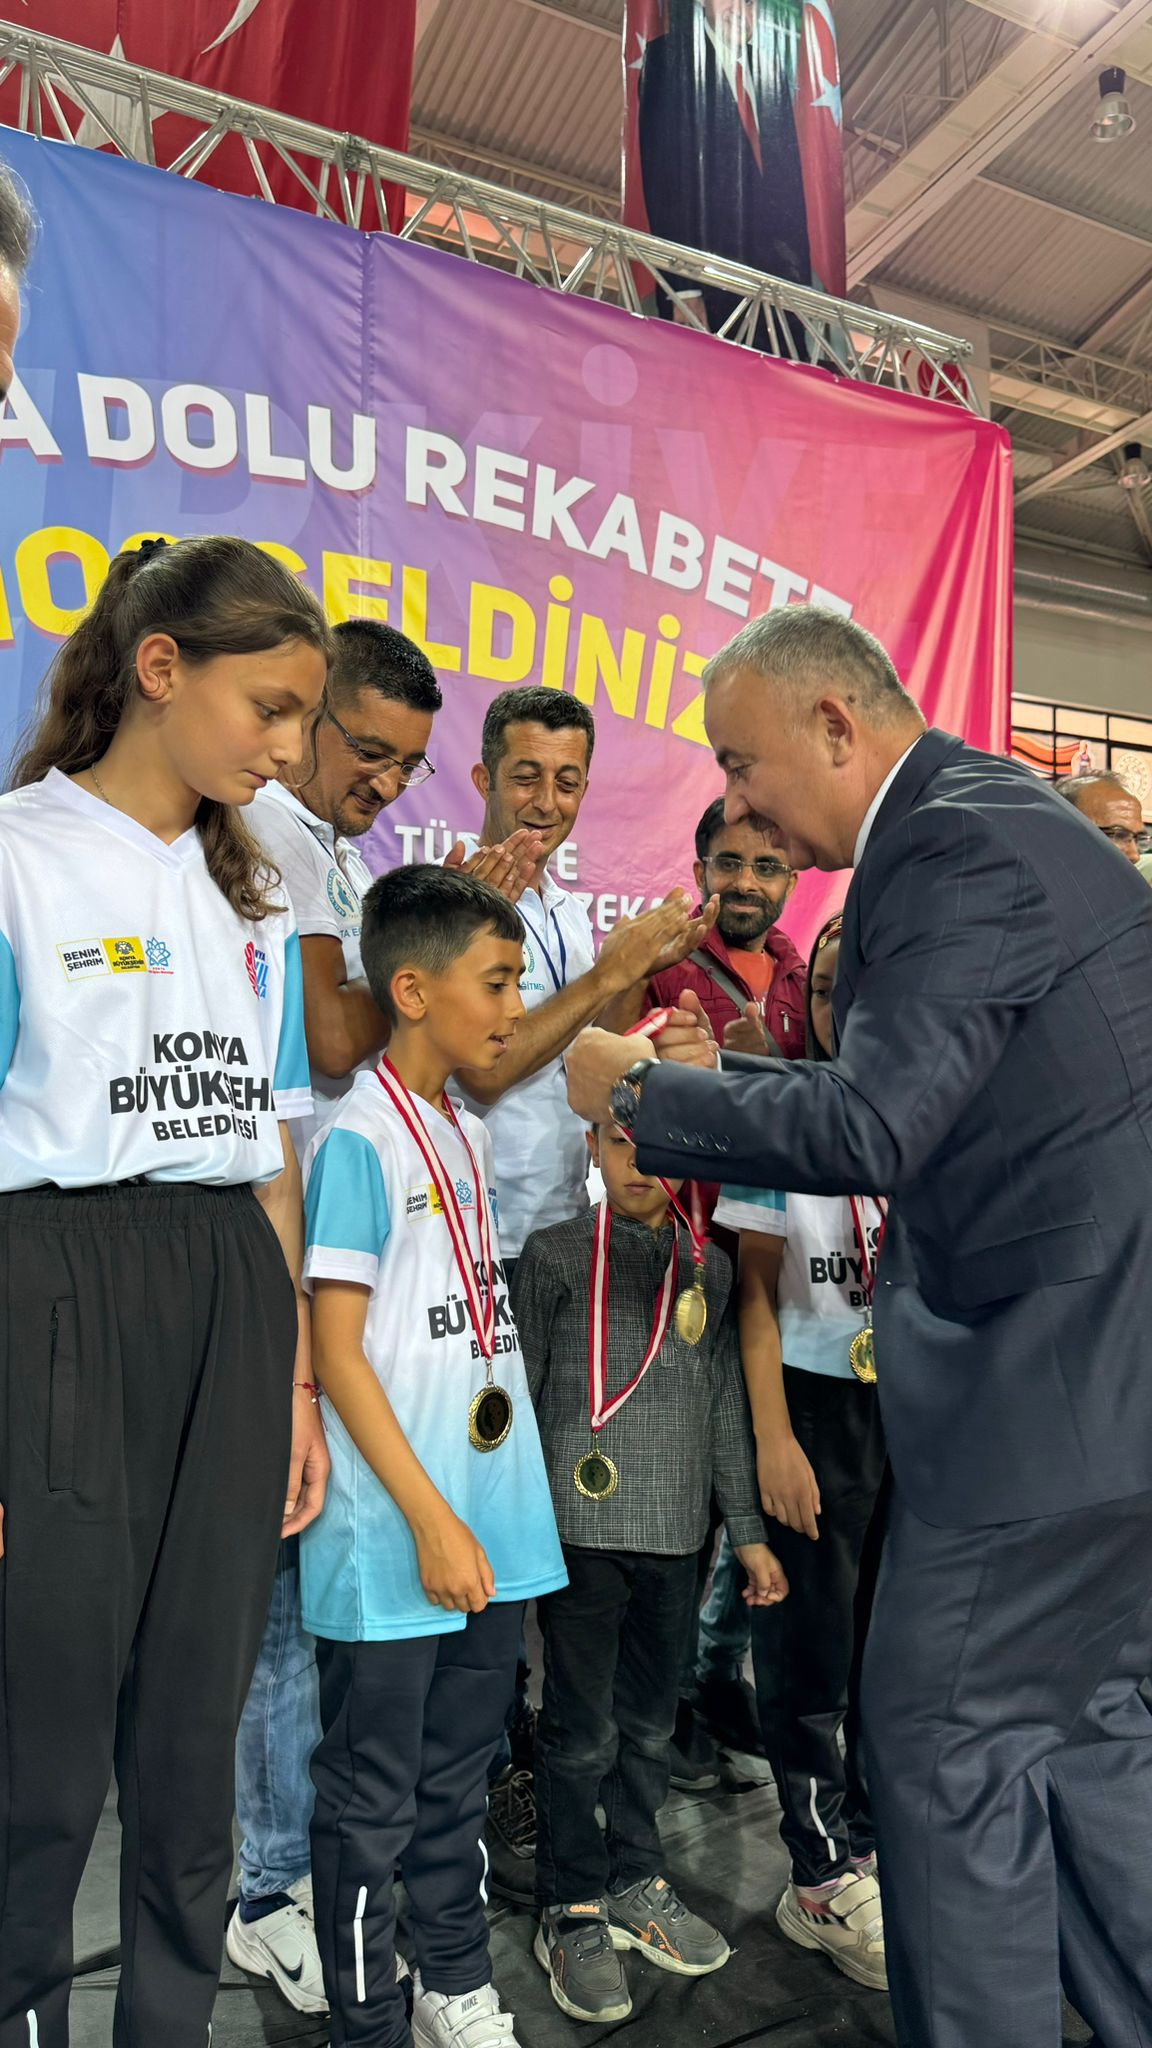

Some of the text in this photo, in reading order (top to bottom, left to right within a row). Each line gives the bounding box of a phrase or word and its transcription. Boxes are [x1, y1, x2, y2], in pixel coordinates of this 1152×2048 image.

[77, 372, 376, 491] DOLU
[254, 541, 713, 749] ELDİNİZ
[63, 948, 101, 962] BENİM
[67, 958, 104, 972] ŞEHRİM
[153, 1031, 248, 1066] KONYA
[109, 1065, 276, 1115] BÜYÜKŞEH
[461, 1995, 479, 2014] NIKE
